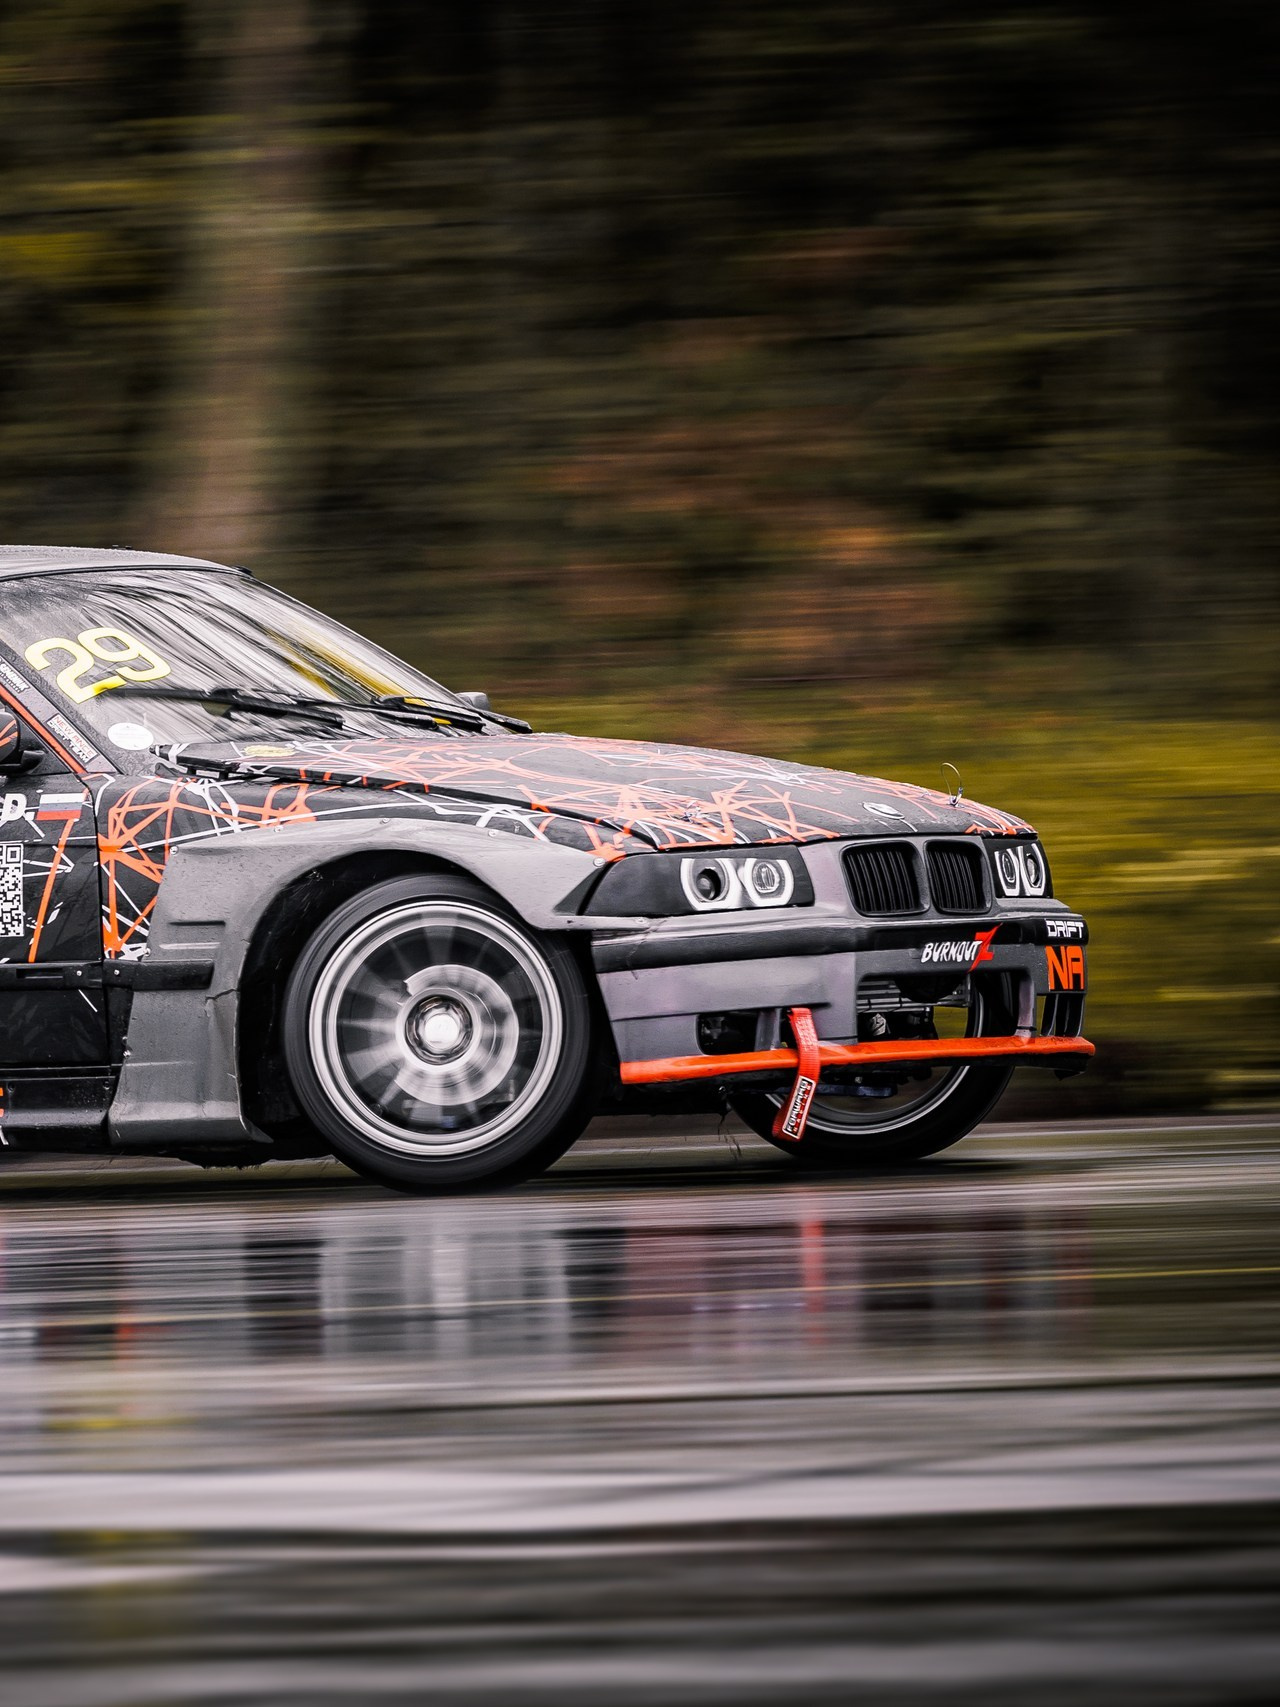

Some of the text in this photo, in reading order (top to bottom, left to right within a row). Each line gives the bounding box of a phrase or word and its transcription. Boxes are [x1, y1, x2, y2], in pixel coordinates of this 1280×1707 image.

[24, 627, 171, 704] 29
[47, 721, 89, 763] DRIFT TEAM
[54, 716, 94, 756] NEW ANCE
[0, 793, 35, 821] D.
[1045, 920, 1084, 939] DRIFT
[1045, 945, 1085, 991] NA
